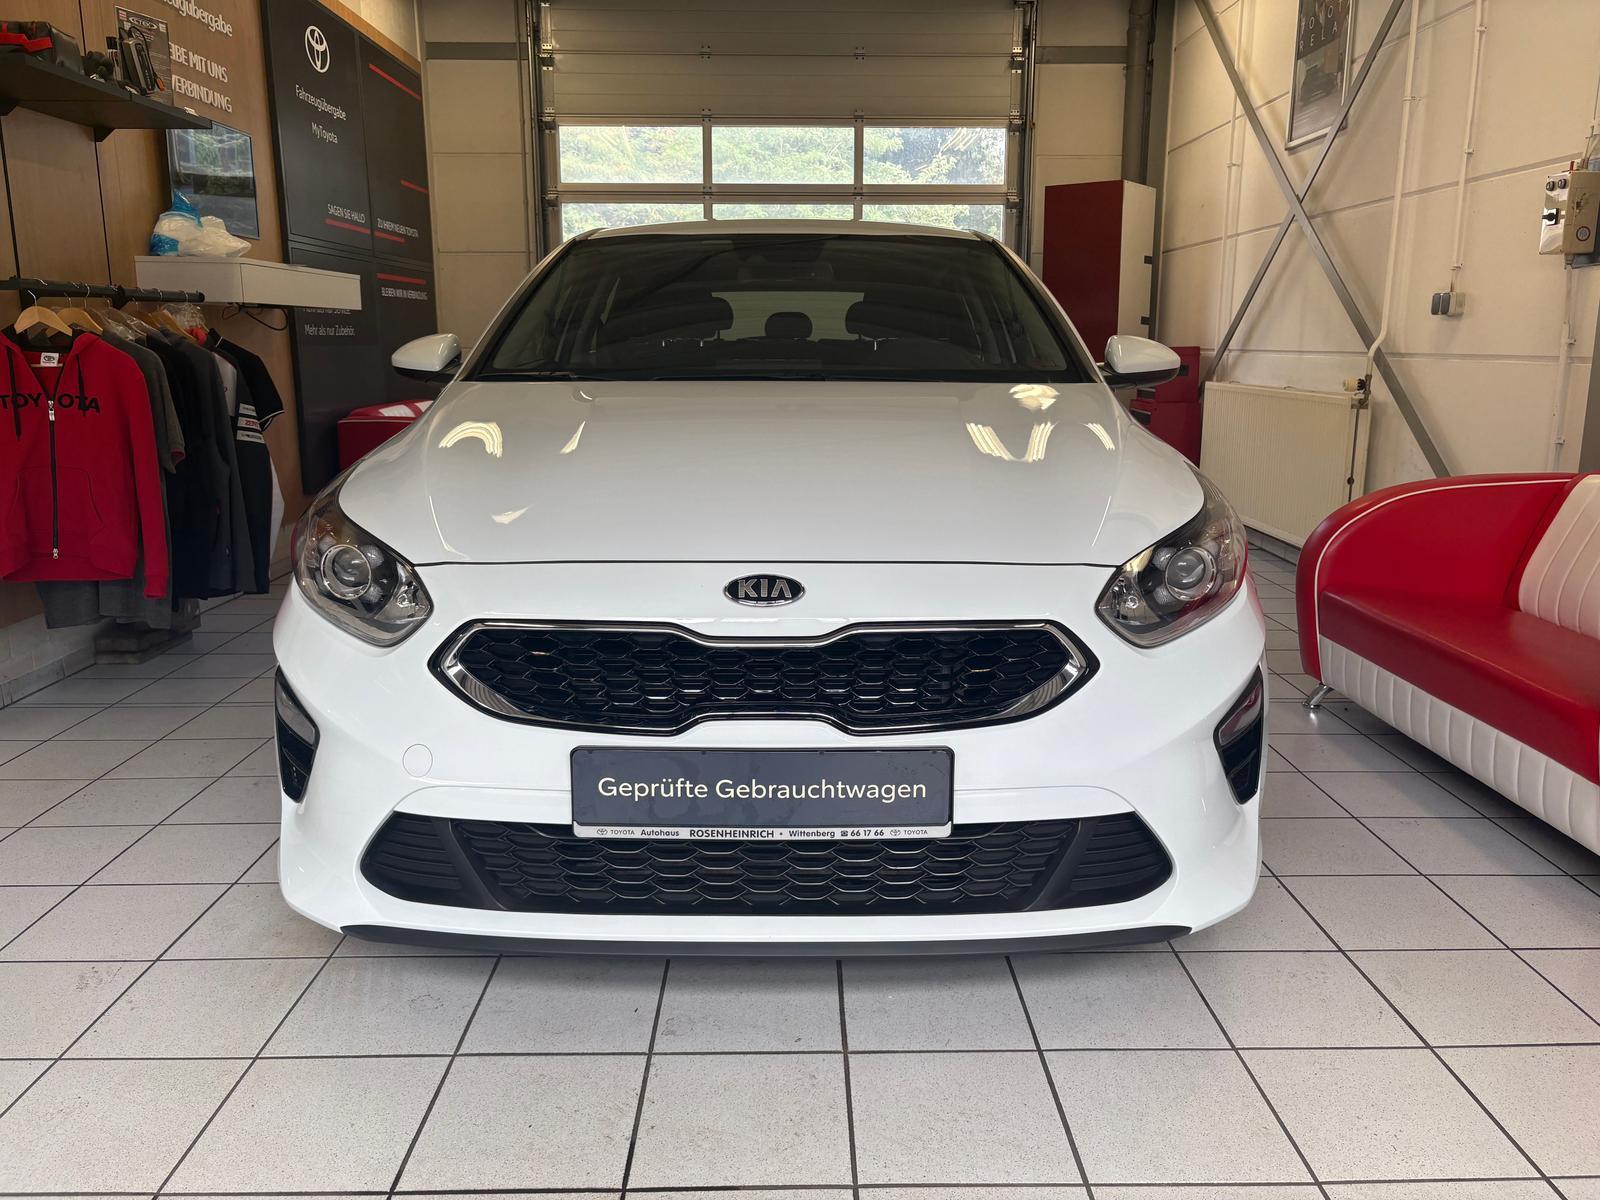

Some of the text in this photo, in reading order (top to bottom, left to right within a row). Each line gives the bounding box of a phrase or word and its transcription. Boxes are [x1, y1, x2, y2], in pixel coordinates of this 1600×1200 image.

[189, 50, 207, 74] MIT
[207, 60, 228, 83] UNS
[295, 84, 347, 121] Fahrzeugübergabe
[311, 121, 338, 144] MyToyota
[304, 323, 317, 336] Mehr
[738, 579, 792, 598] KIA
[598, 777, 927, 804] Geprüfte Gebrauchtwagen
[640, 829, 680, 837] Autohaus
[689, 829, 774, 839] ROSENHEINRICH
[788, 829, 836, 839] Wittenberg
[850, 829, 861, 837] 66
[863, 829, 872, 837] 17
[873, 829, 885, 837] 66
